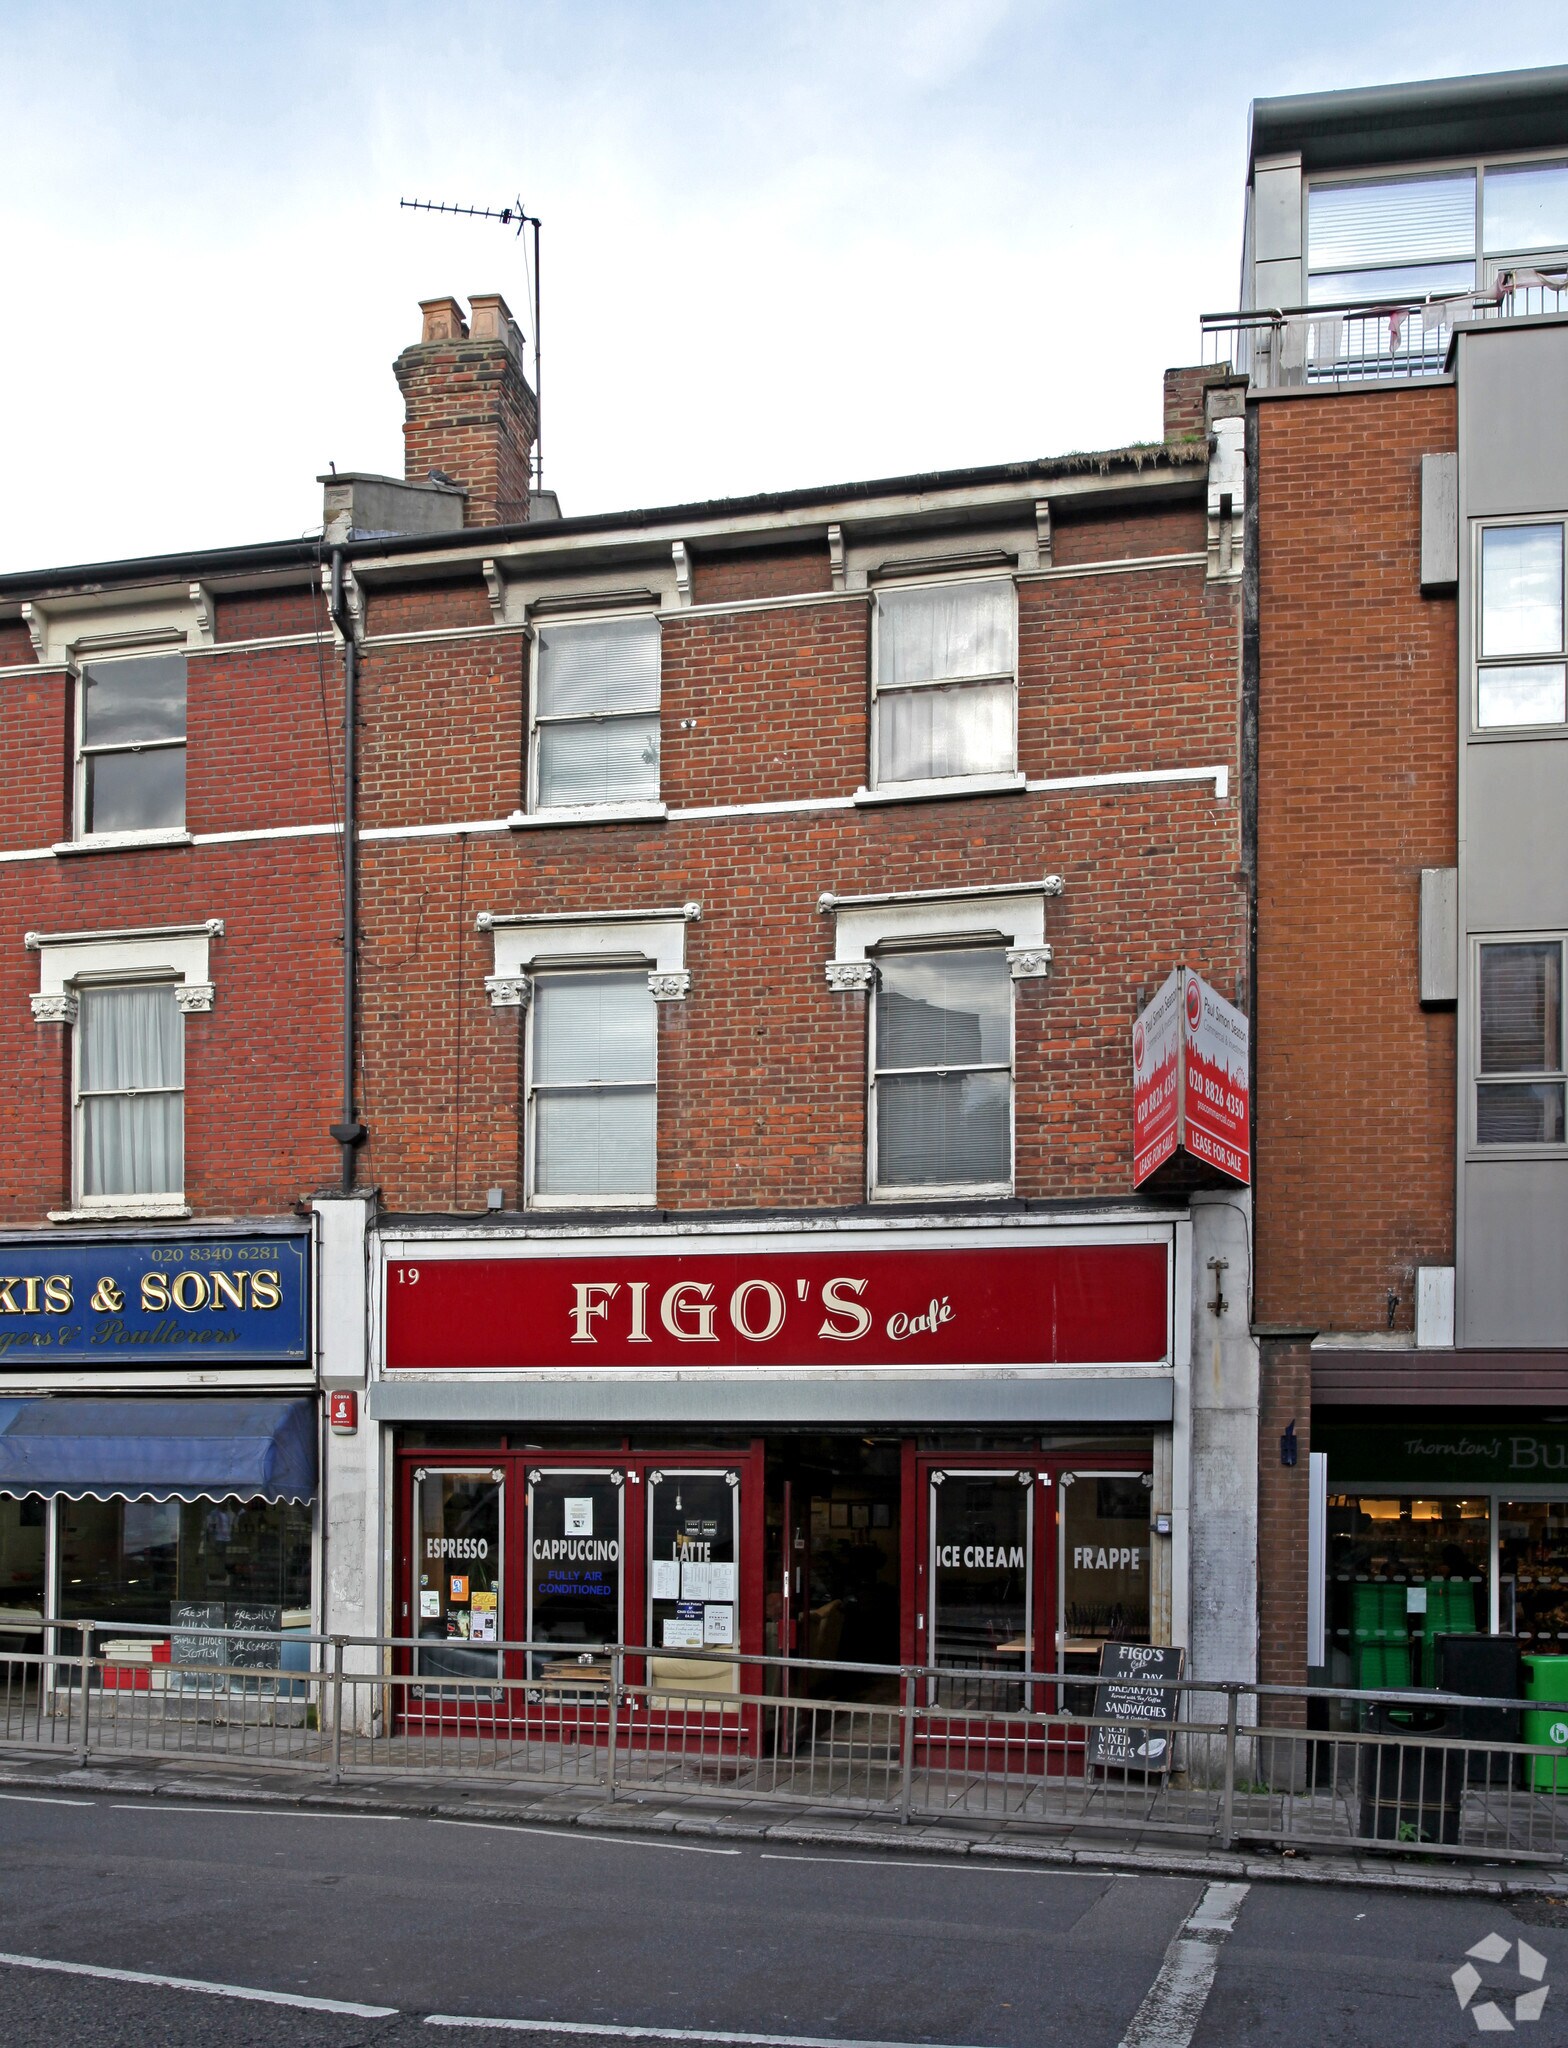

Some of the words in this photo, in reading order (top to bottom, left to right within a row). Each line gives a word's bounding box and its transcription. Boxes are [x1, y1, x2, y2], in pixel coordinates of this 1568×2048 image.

[1204, 996, 1215, 1018] Paul
[1216, 1006, 1231, 1030] Simon
[1203, 1018, 1224, 1044] Commercial
[1138, 1098, 1148, 1124] 020
[1149, 1083, 1163, 1114] 8826
[1189, 1066, 1203, 1094] 020
[1205, 1078, 1224, 1108] 8826
[1226, 1092, 1244, 1120] 4350
[1139, 1151, 1152, 1177] LEASE
[1152, 1142, 1162, 1164] FOR
[1162, 1131, 1174, 1156] SALE
[1192, 1130, 1212, 1157] LEASE
[1213, 1142, 1226, 1164] FOR
[1226, 1150, 1242, 1173] SALE
[152, 1249, 183, 1262] 020
[190, 1248, 233, 1261] 8340
[238, 1246, 279, 1260] 6281
[397, 1268, 420, 1285] 19
[90, 1276, 126, 1313] &
[141, 1269, 283, 1313] SONS
[568, 1277, 872, 1343] FIGO'S
[886, 1296, 956, 1341] Café
[90, 1318, 241, 1346] Poulterers
[1404, 1436, 1502, 1458] Thornton's
[1508, 1437, 1568, 1468] Bu
[427, 1537, 488, 1559] ESPRESSO
[533, 1539, 619, 1562] CAPPUCCINO
[672, 1541, 711, 1562] LATTE
[936, 1545, 960, 1567] ICE
[963, 1546, 1024, 1568] CREAM
[1073, 1547, 1140, 1570] FRAPPE
[548, 1570, 580, 1581] FULLY
[584, 1571, 602, 1581] AIR
[538, 1583, 611, 1595] CONDITIONED
[178, 1606, 210, 1618] FRESH
[173, 1635, 196, 1645] SMALL
[180, 1645, 218, 1658] SCOTTISH
[1119, 1646, 1164, 1662] FIGO'S
[1105, 1701, 1166, 1718] SANDWICHES
